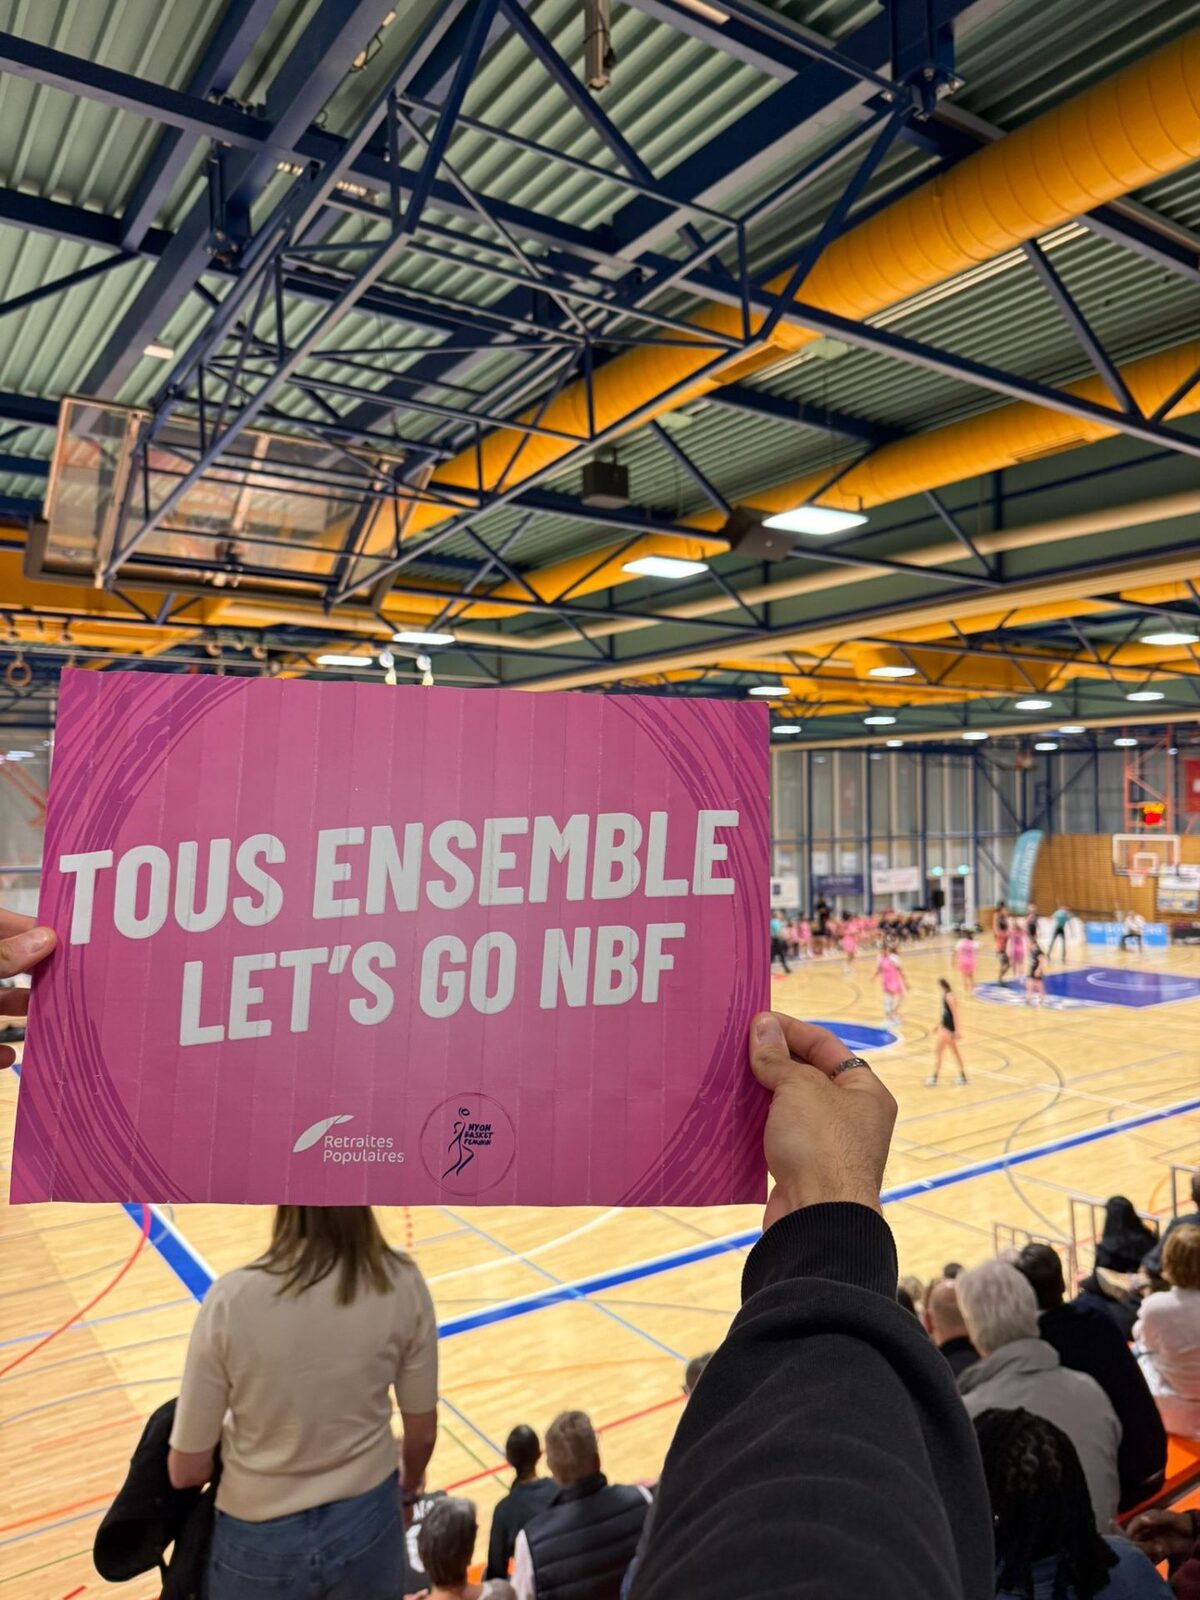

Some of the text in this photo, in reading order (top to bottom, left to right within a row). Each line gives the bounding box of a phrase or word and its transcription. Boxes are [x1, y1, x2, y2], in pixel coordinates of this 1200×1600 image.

[59, 809, 740, 944] TOUS ENSEMBLE
[419, 931, 518, 1019] GO
[540, 922, 686, 1010] NBF
[323, 1149, 405, 1165] Populaires
[324, 1134, 394, 1148] Retraites
